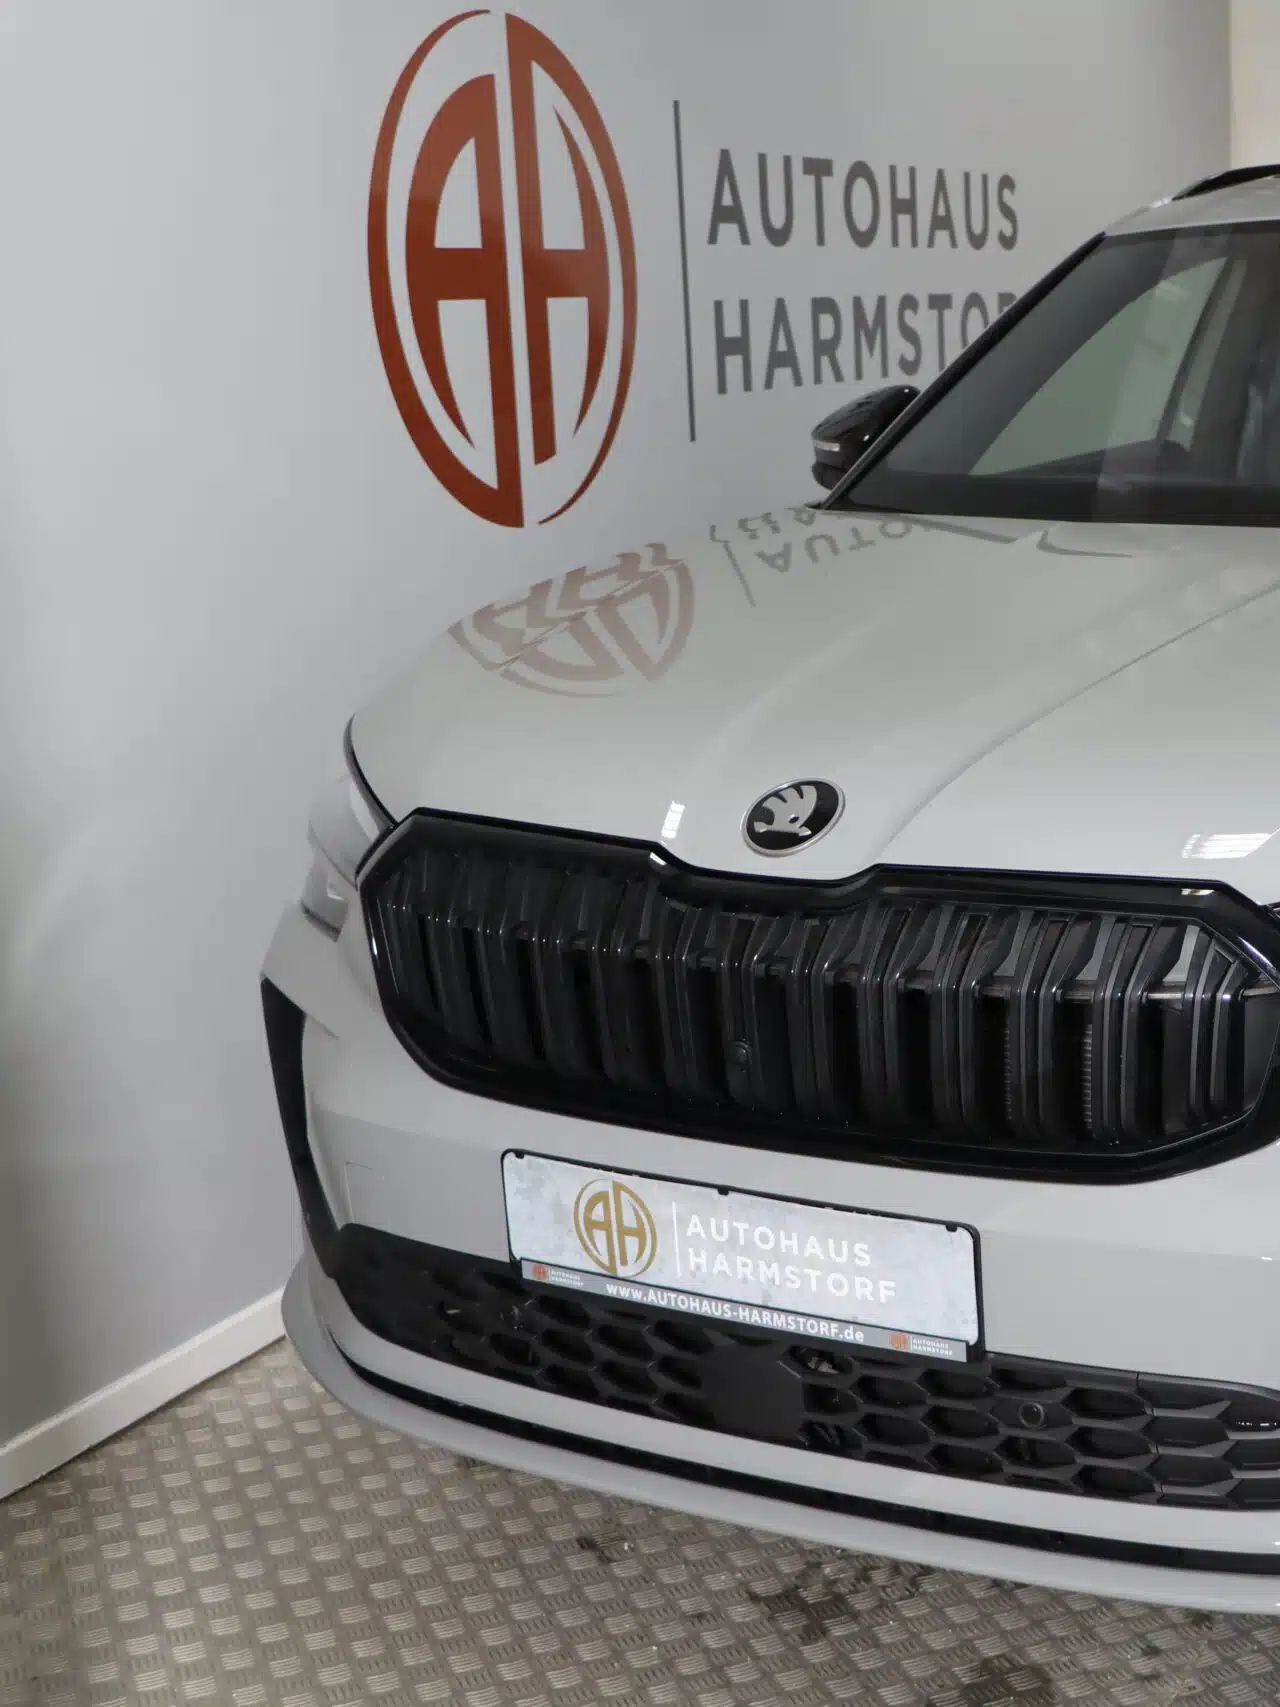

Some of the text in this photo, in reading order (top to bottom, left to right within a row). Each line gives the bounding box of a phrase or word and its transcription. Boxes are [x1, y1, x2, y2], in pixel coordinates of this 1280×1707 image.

[707, 149, 1019, 250] AUTOHAUS
[686, 1215, 872, 1267] AUTOHAUS
[688, 1248, 897, 1303] HARMSTORF
[606, 1283, 865, 1342] www.AUTOHAUS-HARMSTORF.de
